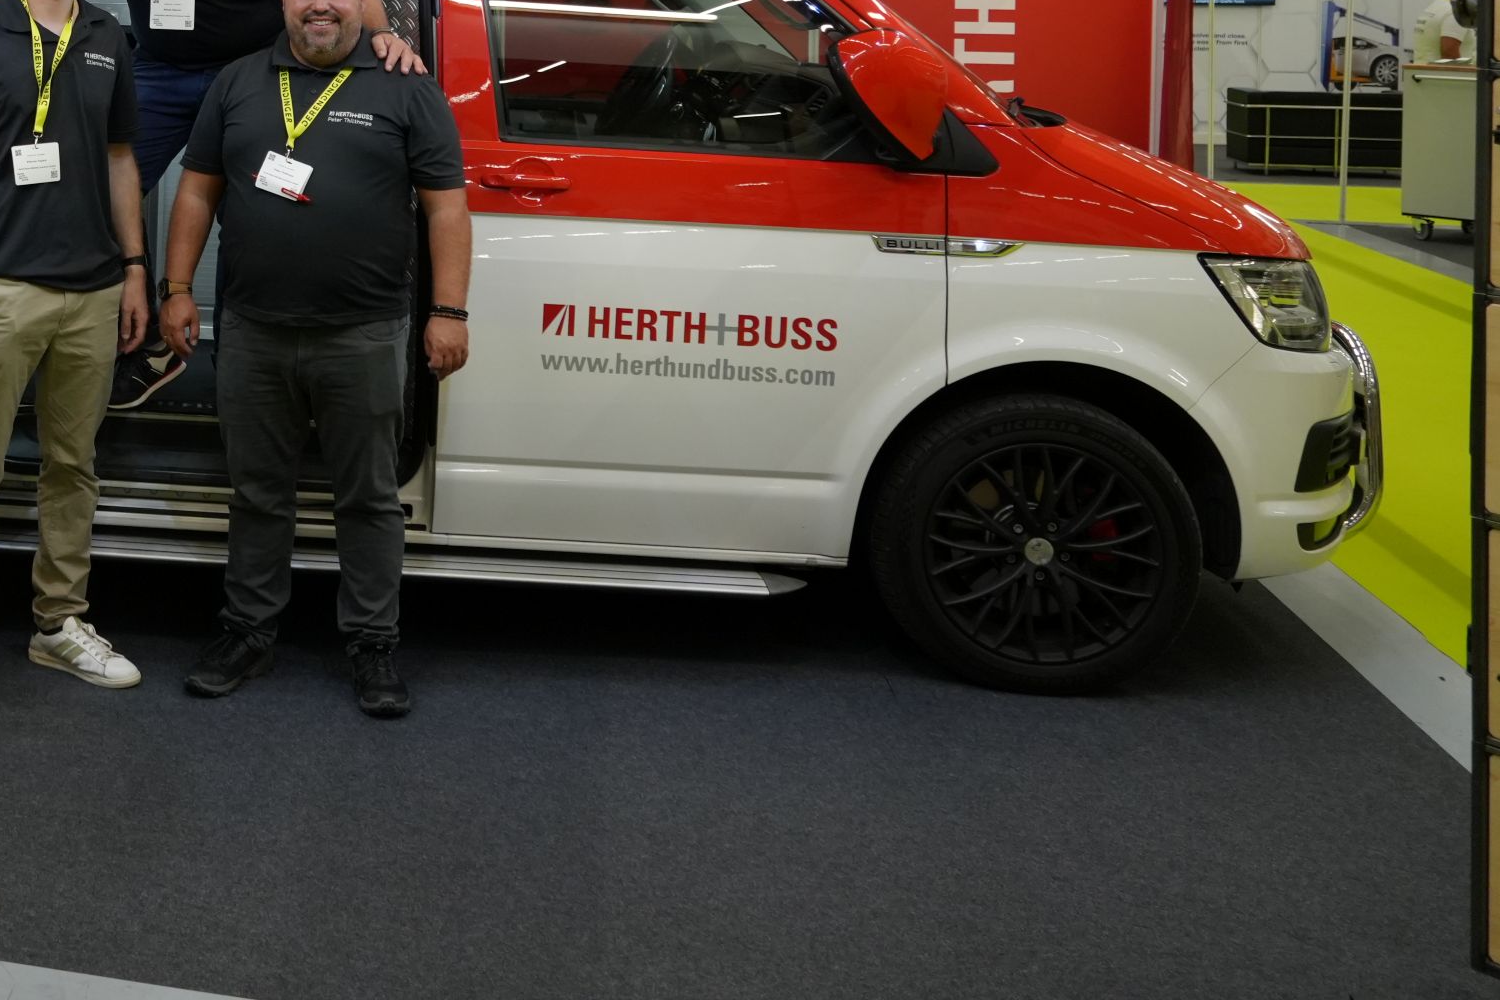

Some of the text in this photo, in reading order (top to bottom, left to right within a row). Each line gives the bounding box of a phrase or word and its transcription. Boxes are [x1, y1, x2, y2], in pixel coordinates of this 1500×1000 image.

[886, 239, 940, 250] BULLI
[587, 305, 838, 352] HERTH+BUSS
[541, 352, 836, 387] www.herthundbuss.com
